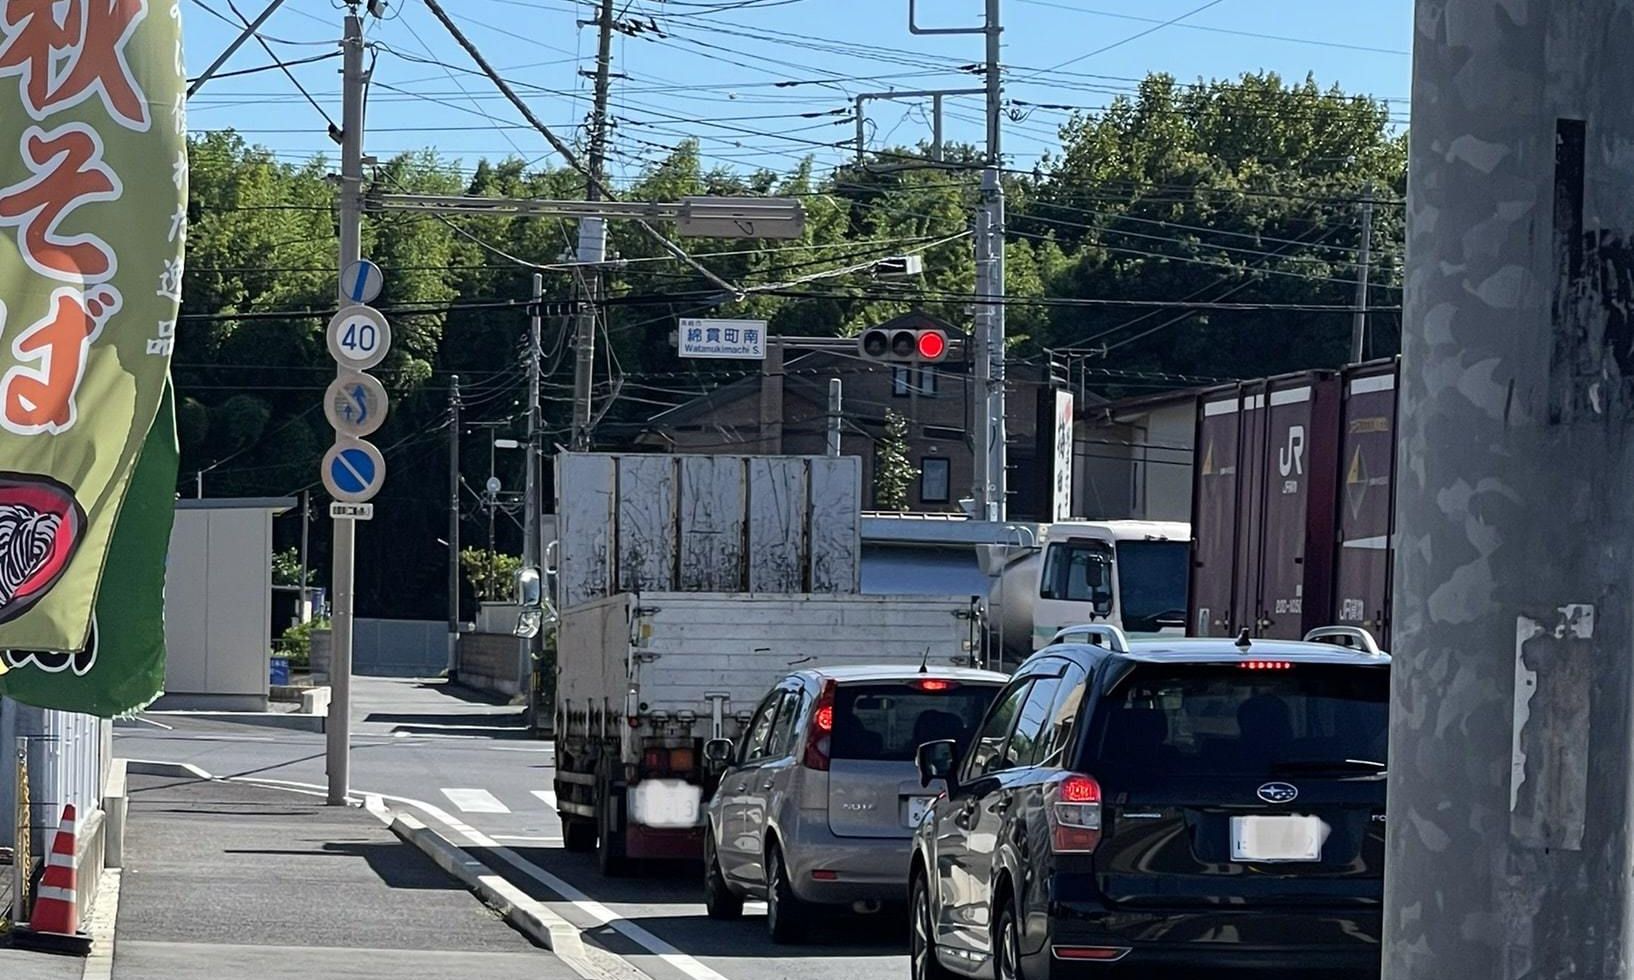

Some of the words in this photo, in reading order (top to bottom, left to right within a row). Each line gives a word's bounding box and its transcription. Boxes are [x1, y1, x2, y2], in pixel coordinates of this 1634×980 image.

[342, 323, 375, 351] 40
[688, 328, 759, 344] 綿貫町南
[1279, 425, 1305, 477] JR
